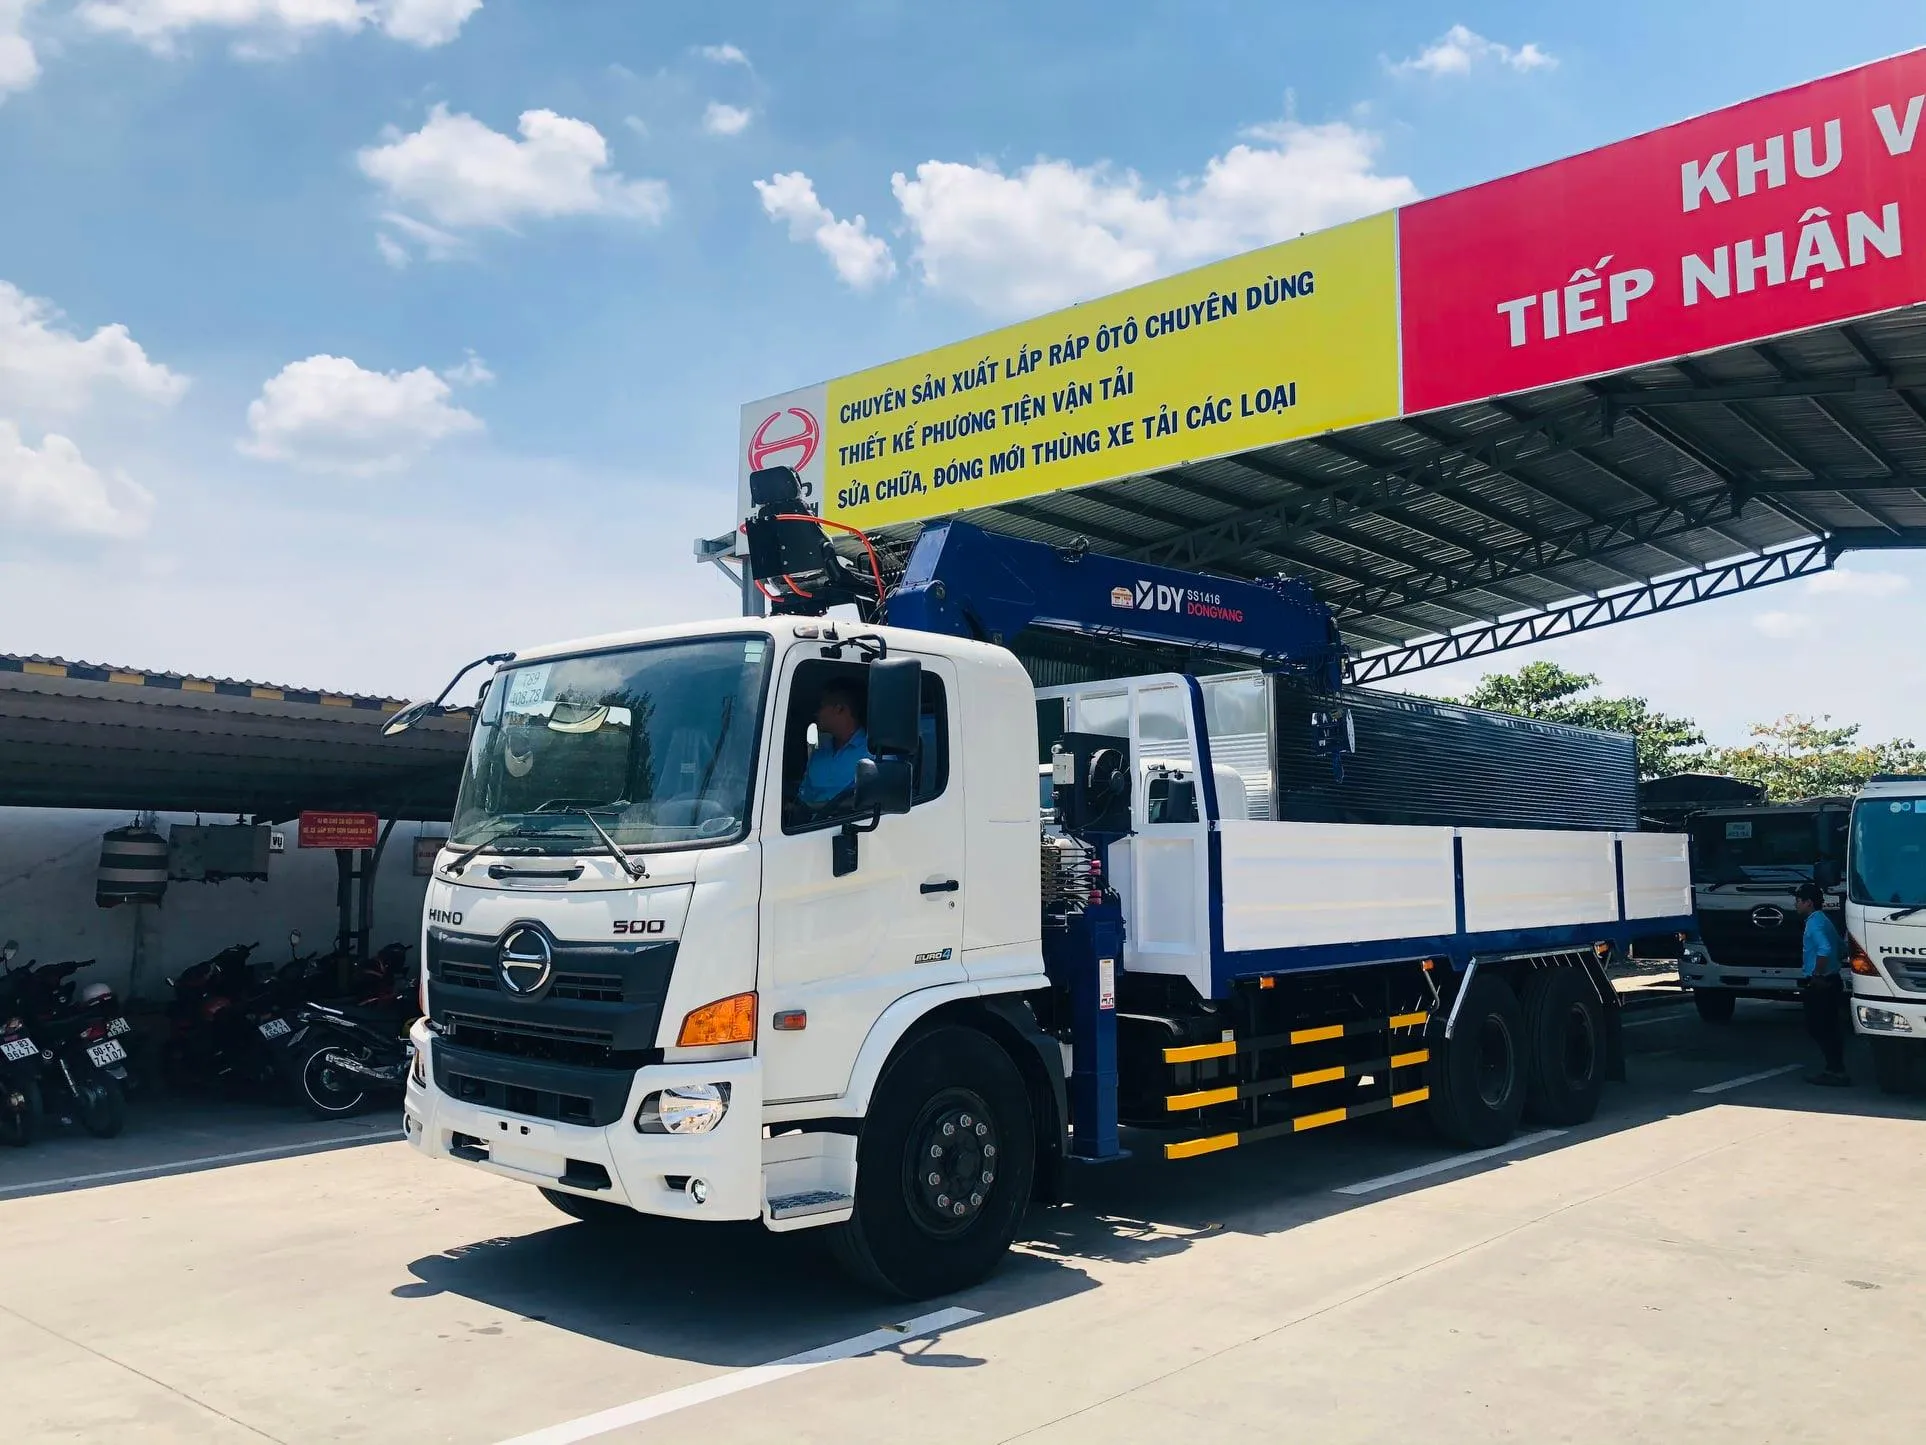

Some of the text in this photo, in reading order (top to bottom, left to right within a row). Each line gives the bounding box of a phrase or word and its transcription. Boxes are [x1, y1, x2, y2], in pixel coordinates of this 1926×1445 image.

[1681, 118, 1843, 213] KHU
[1497, 202, 1903, 347] TIẾP NHẬN
[840, 271, 1314, 424] CHUYÊN SẢN XUẤT LẮP RÁP ÔTÔ CHUYÊN DÙNG
[839, 365, 1133, 466] THIẾT KẾ PHƯƠNG TIỆN VẬN TẢI
[837, 480, 870, 509] SỬA
[876, 470, 927, 501] CHỮA,
[933, 458, 983, 488] ĐÓNG
[989, 443, 1025, 475] MỚI
[1032, 430, 1100, 465] THÙNG
[1107, 421, 1134, 448] XE
[1142, 404, 1178, 439] TẢI
[1186, 396, 1232, 429] CÁC
[1241, 382, 1296, 415] LOẠI
[1157, 584, 1185, 613] DY
[1187, 589, 1221, 605] SS1416
[1187, 602, 1244, 623] DONGYANG
[429, 908, 463, 926] HINO
[613, 919, 665, 934] 500
[93, 1042, 116, 1057] 60-F1
[94, 1049, 122, 1066] 74107
